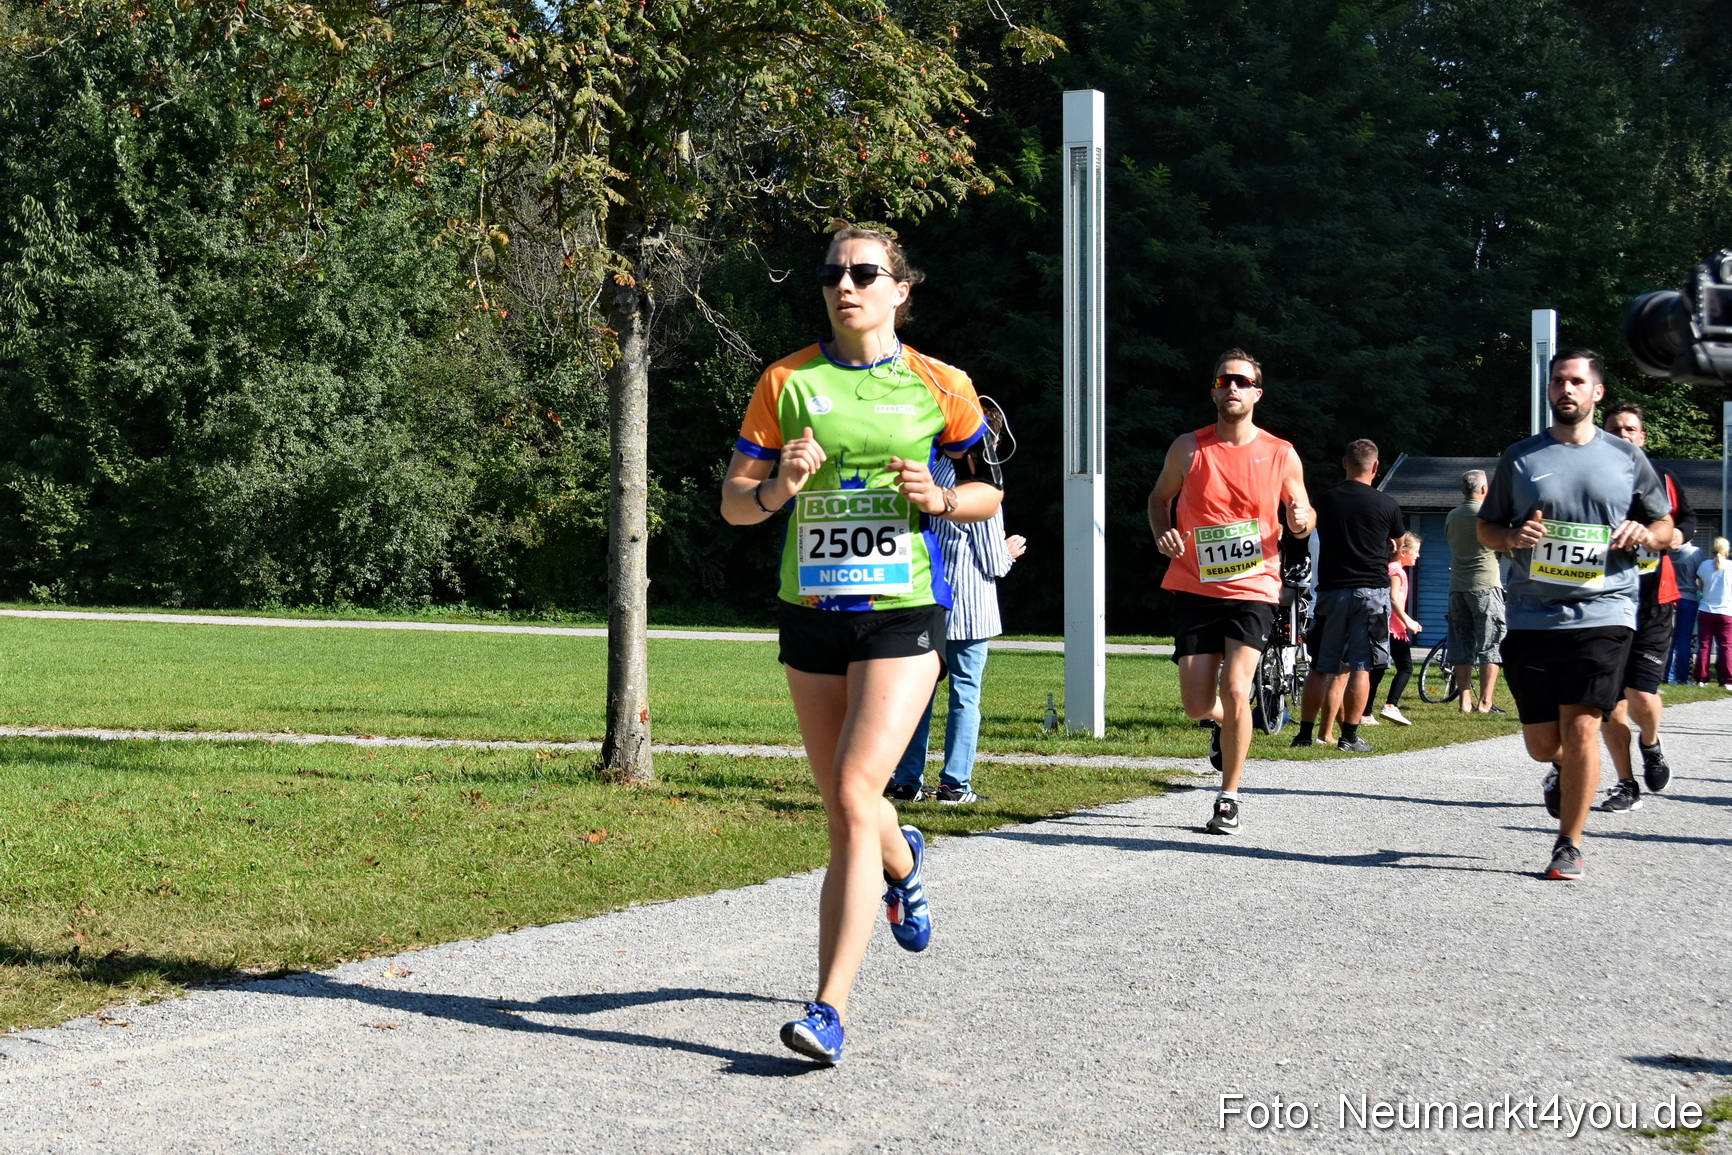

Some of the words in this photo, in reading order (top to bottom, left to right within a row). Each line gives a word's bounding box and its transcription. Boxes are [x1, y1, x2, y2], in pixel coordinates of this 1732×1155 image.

[805, 495, 898, 518] BOCK
[1200, 523, 1252, 541] BOCK
[1543, 523, 1601, 540] BOCK
[810, 526, 896, 559] 2506
[1205, 540, 1254, 563] 1149
[1543, 542, 1598, 566] 1154
[820, 568, 885, 583] NICOLE
[1207, 561, 1257, 575] SEBASTIAN
[1538, 565, 1597, 579] ALEXANDER
